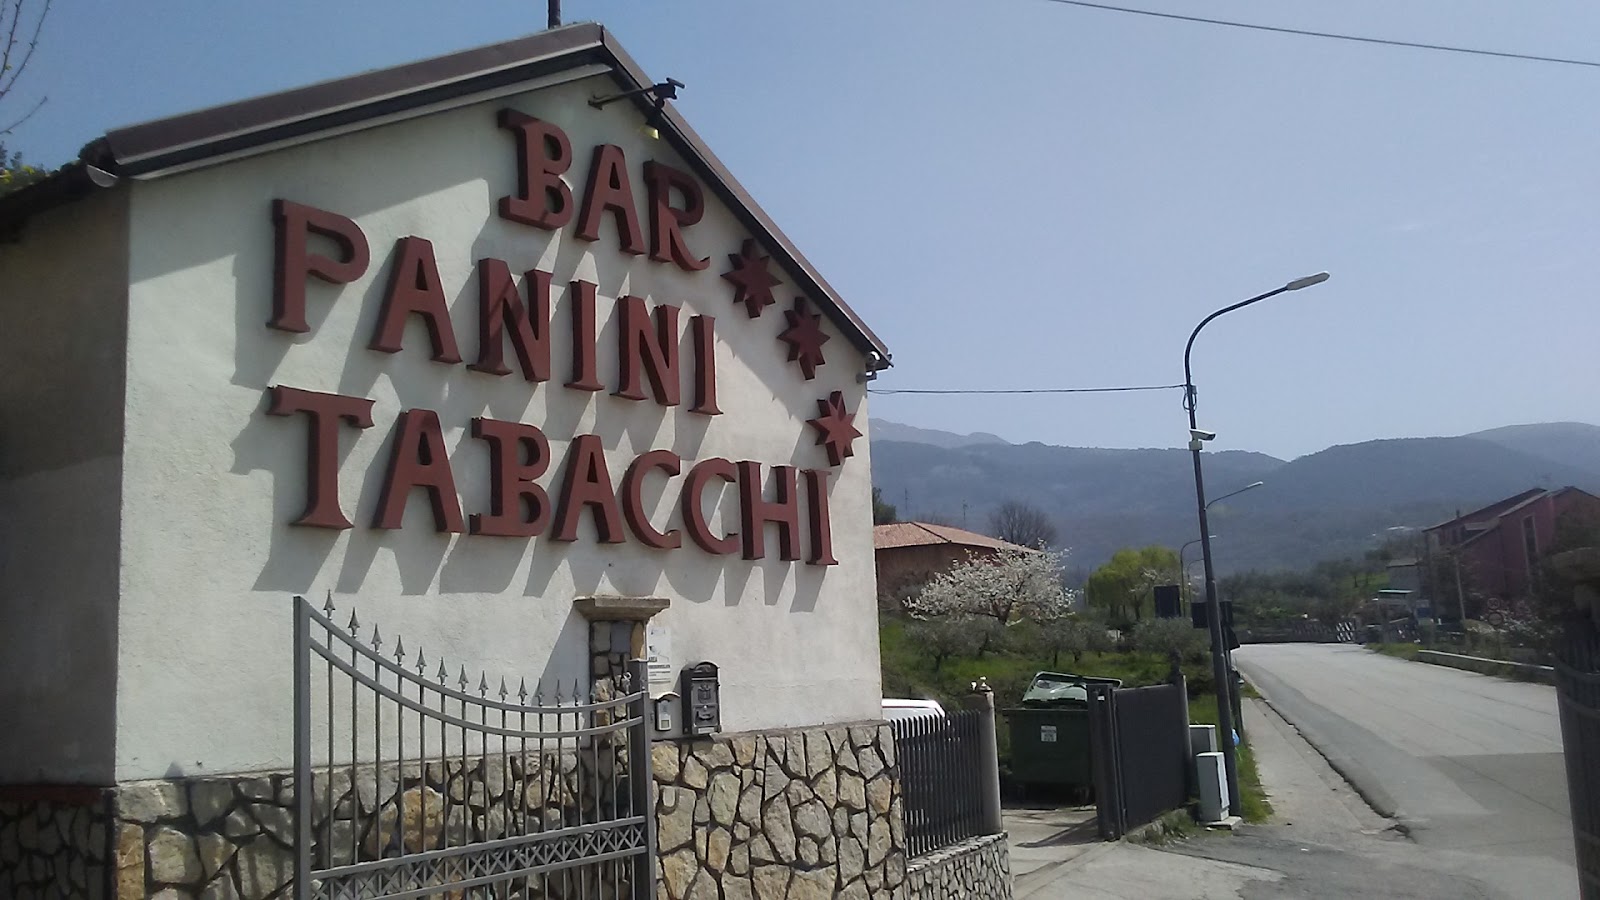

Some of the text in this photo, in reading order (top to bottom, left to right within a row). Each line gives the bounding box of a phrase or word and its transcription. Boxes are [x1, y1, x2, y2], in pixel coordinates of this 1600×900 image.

[497, 107, 711, 272] BAR
[266, 198, 724, 416] PANINI
[266, 384, 839, 566] TABACCHI
